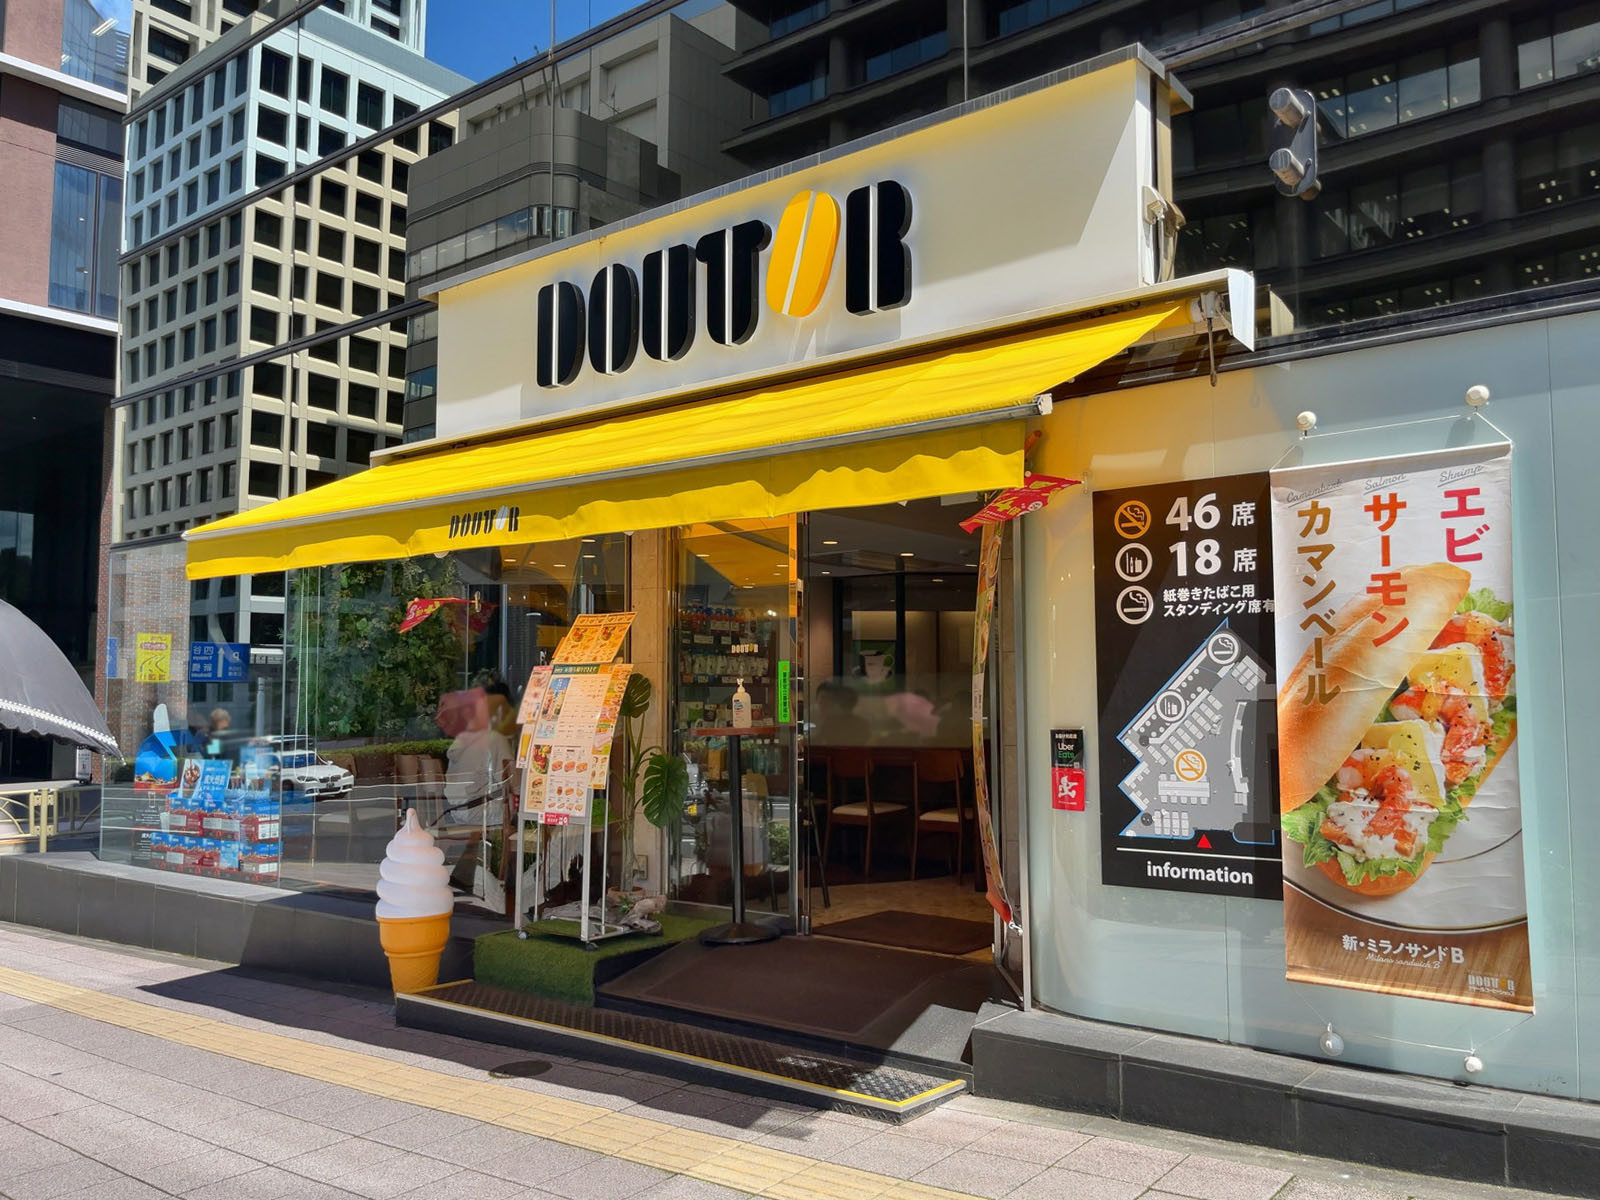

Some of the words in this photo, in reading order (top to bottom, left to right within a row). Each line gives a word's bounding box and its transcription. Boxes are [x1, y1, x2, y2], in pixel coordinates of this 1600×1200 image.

[537, 180, 913, 389] DOUTOR
[1364, 473, 1407, 490] Salmon
[1440, 465, 1485, 483] Shrimp
[448, 505, 520, 539] DOUTOR
[1165, 493, 1221, 531] 46
[1231, 501, 1256, 527] 席
[1440, 487, 1490, 563] エビ
[1168, 538, 1222, 577] 18
[1232, 547, 1257, 573] 席
[1363, 492, 1410, 648] サーモン
[1163, 584, 1255, 603] 紙巻きたばこ用
[1297, 500, 1341, 706] カマンベール
[1058, 743, 1075, 751] Uber
[1058, 751, 1075, 759] Eats
[1147, 860, 1254, 885] information
[1432, 960, 1441, 969] B
[1468, 974, 1516, 992] DOUTOR
